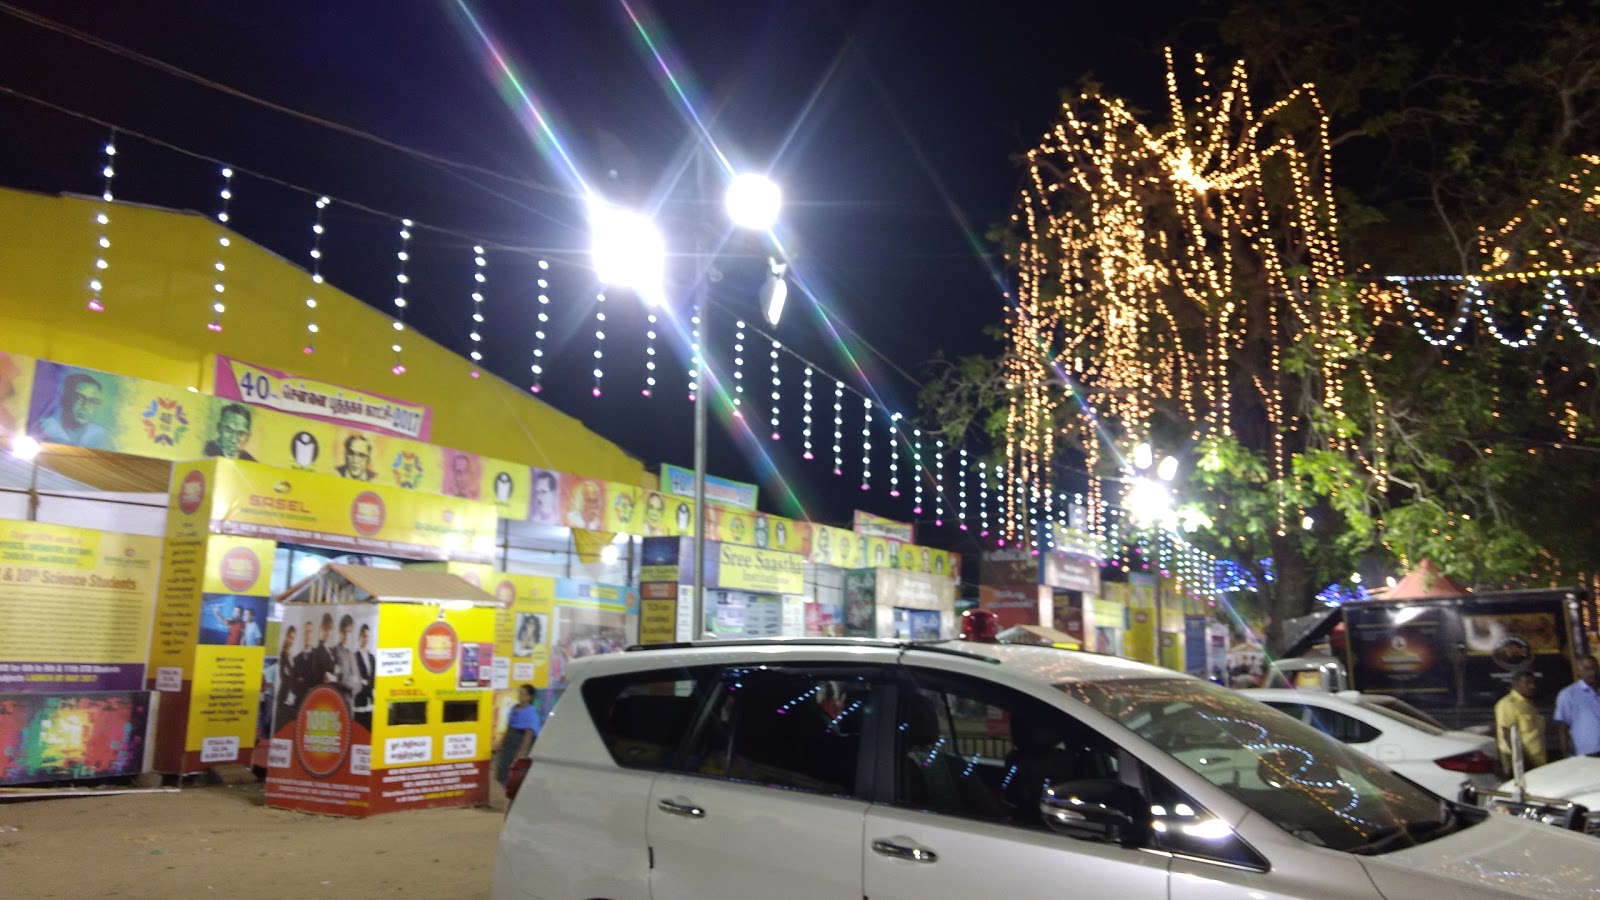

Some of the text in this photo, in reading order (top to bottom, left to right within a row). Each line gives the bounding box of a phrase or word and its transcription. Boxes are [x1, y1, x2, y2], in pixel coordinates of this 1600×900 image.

[721, 546, 750, 568] Sree
[41, 570, 87, 587] Science
[88, 574, 137, 591] Students
[306, 710, 342, 732] 100%
